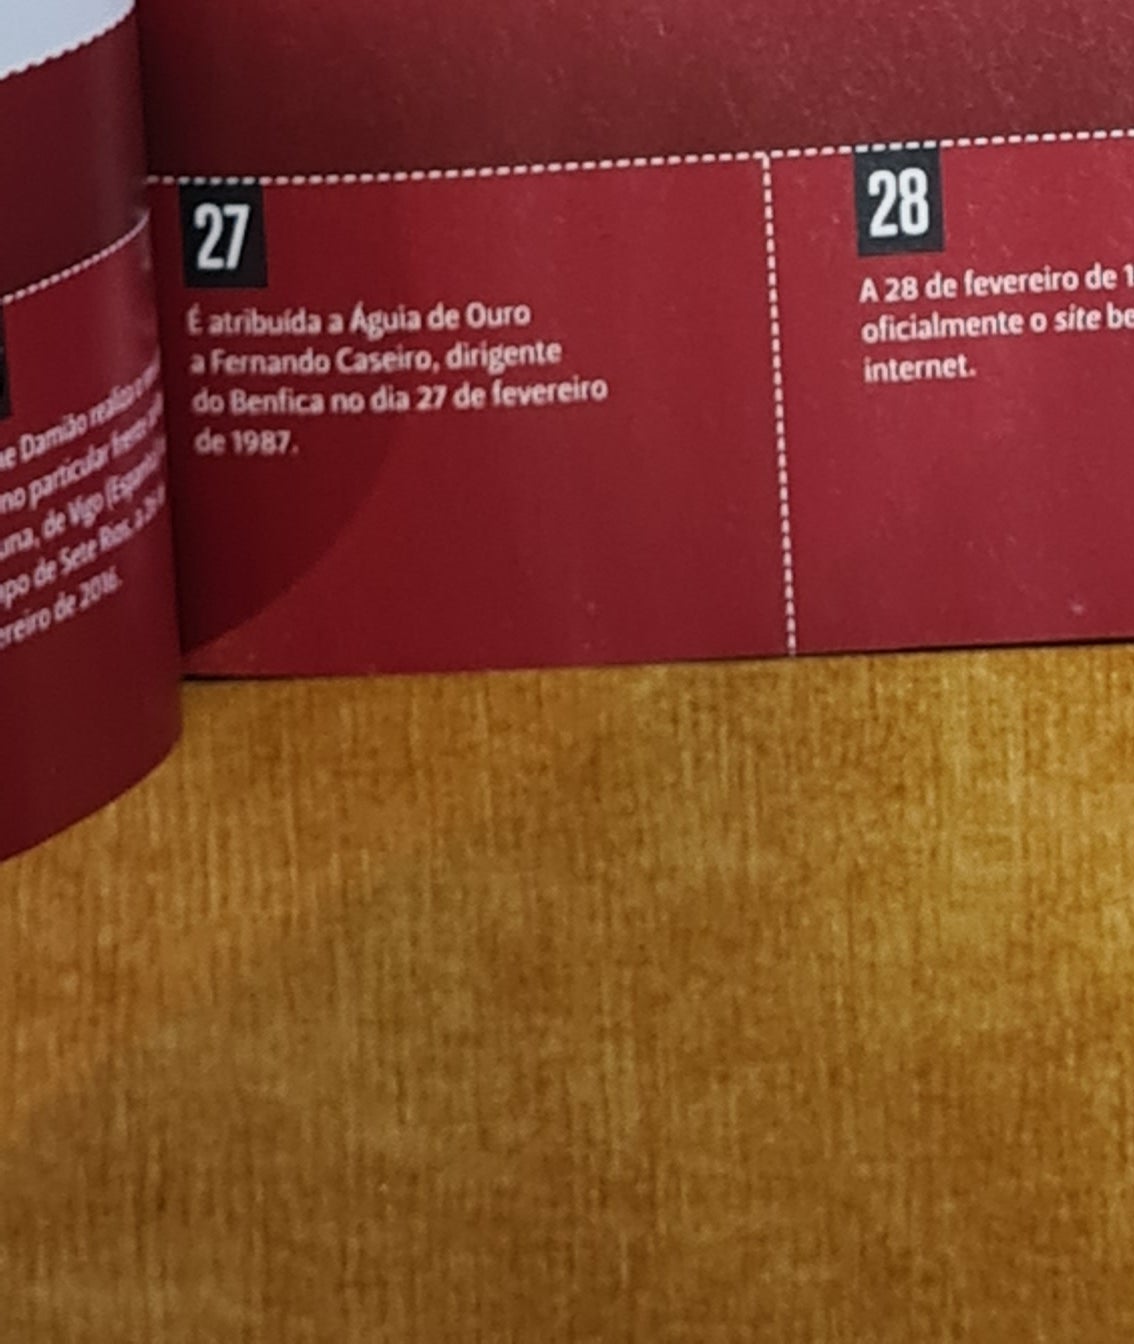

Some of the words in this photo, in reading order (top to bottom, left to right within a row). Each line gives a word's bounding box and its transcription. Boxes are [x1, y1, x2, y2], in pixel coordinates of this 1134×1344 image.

[868, 167, 930, 239] 28
[195, 203, 251, 270] 27
[859, 278, 879, 302] A
[885, 276, 918, 301] 28
[925, 271, 957, 299] de
[965, 264, 1079, 297] fevereiro
[1085, 262, 1117, 290] de
[188, 304, 202, 334] É
[209, 306, 321, 336] atribuída
[328, 314, 343, 333] a
[350, 302, 421, 341] Águia
[428, 303, 459, 330] de
[466, 301, 531, 325] Ouro
[862, 310, 1023, 343] oficialmente
[1030, 313, 1047, 332] o
[1053, 303, 1101, 330] site
[191, 354, 204, 373] a
[211, 348, 330, 374] Fernando
[336, 346, 439, 374] Caseiro,
[446, 340, 562, 375] dirigente
[864, 354, 976, 383] internet.
[193, 390, 224, 414] do
[231, 386, 324, 414] Benfica
[331, 391, 364, 410] no
[371, 386, 409, 410] dia
[416, 385, 446, 409] 27
[453, 381, 486, 408] de
[493, 375, 608, 405] fevereiro
[196, 429, 226, 454] de
[233, 429, 298, 455] 1987.
[43, 509, 66, 538] de
[33, 557, 57, 588] de
[54, 592, 76, 621] de
